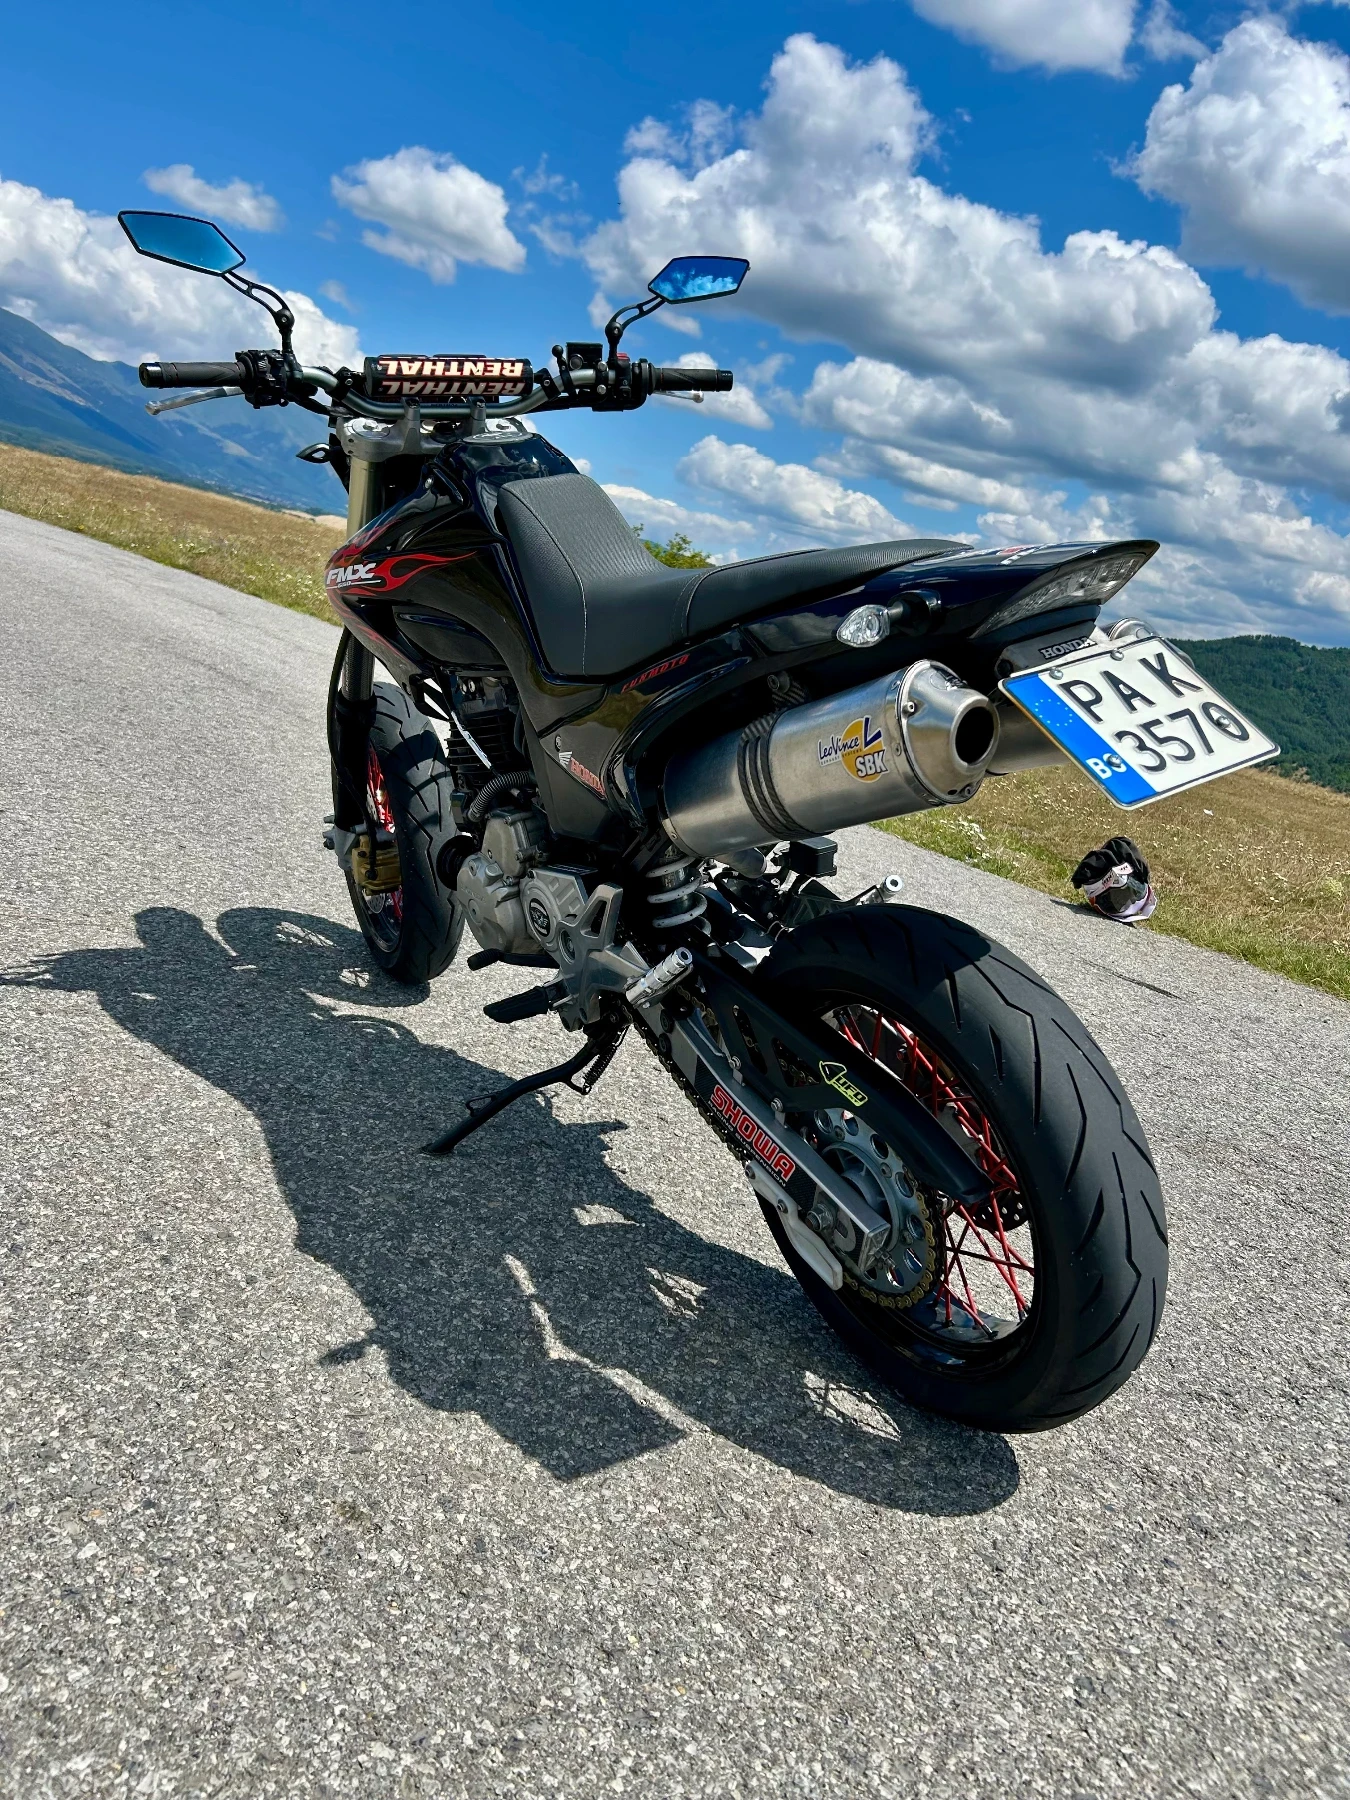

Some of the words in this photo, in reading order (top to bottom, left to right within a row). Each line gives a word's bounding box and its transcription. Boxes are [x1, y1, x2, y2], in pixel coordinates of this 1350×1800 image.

[379, 360, 524, 377] RENTHAL
[381, 381, 526, 395] RENTHAL
[326, 563, 377, 585] FMX
[1040, 637, 1097, 659] HONDA
[819, 736, 860, 760] LeoVince
[1113, 701, 1250, 773] 3570
[570, 757, 606, 797] HONDA
[855, 749, 889, 778] SBK
[834, 1075, 867, 1103] UFO
[707, 1100, 734, 1132] RACING
[735, 1132, 787, 1188] SUSPENSION
[711, 1085, 796, 1182] SHOWA
